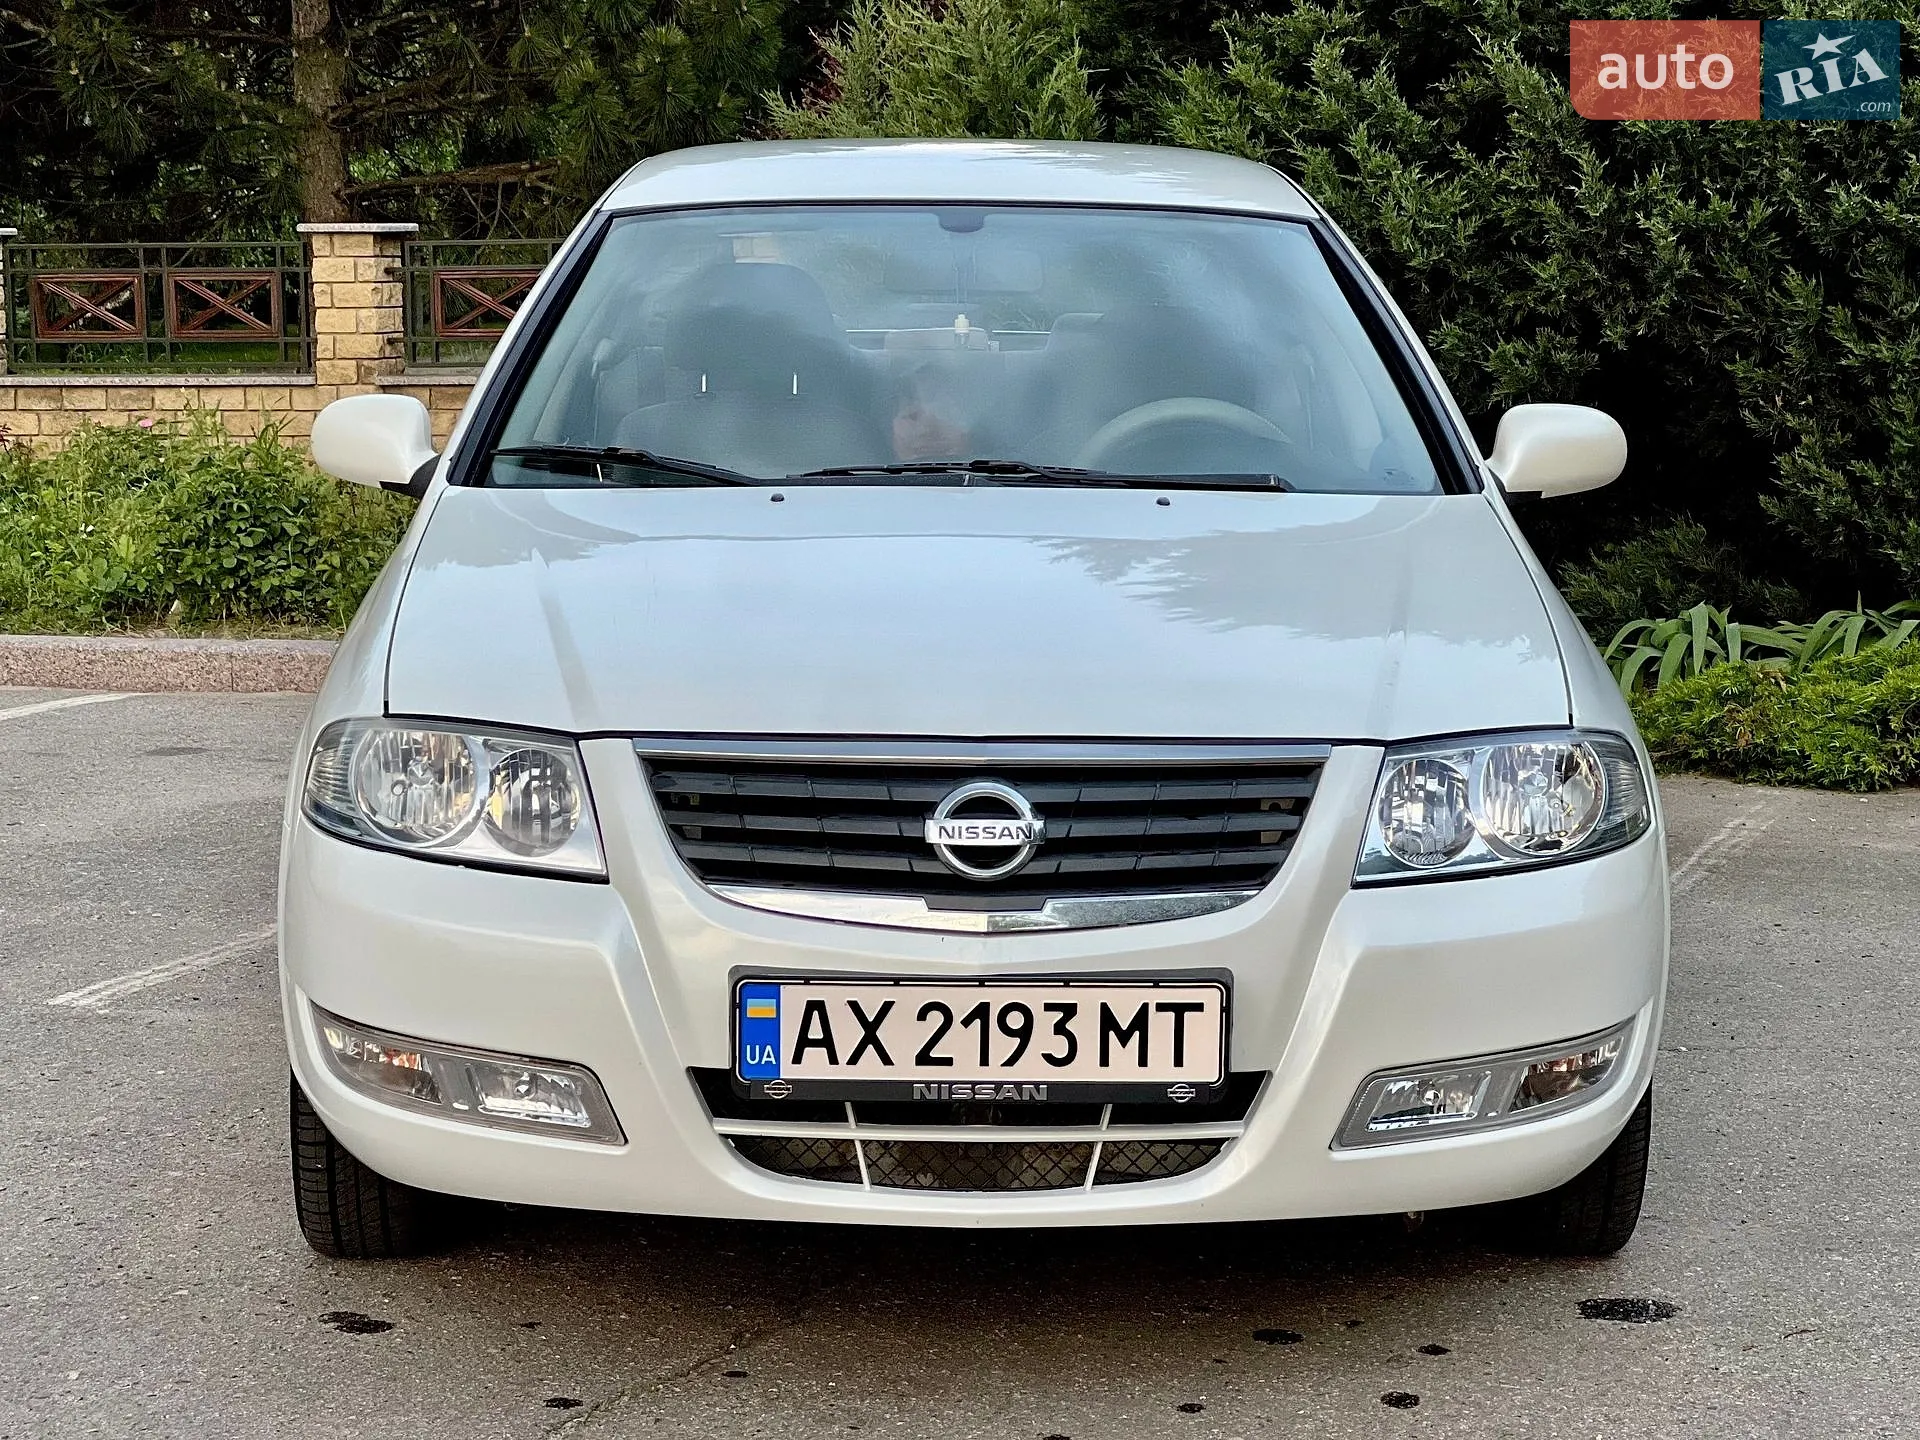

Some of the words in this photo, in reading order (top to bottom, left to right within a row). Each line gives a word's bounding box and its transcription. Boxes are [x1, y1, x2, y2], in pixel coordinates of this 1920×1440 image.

[938, 824, 1032, 840] NISSAN
[791, 999, 896, 1066] AX
[915, 1001, 1079, 1068] 2193
[1099, 1001, 1205, 1068] MT
[746, 1044, 777, 1065] UA
[913, 1083, 1048, 1102] NISSAN
